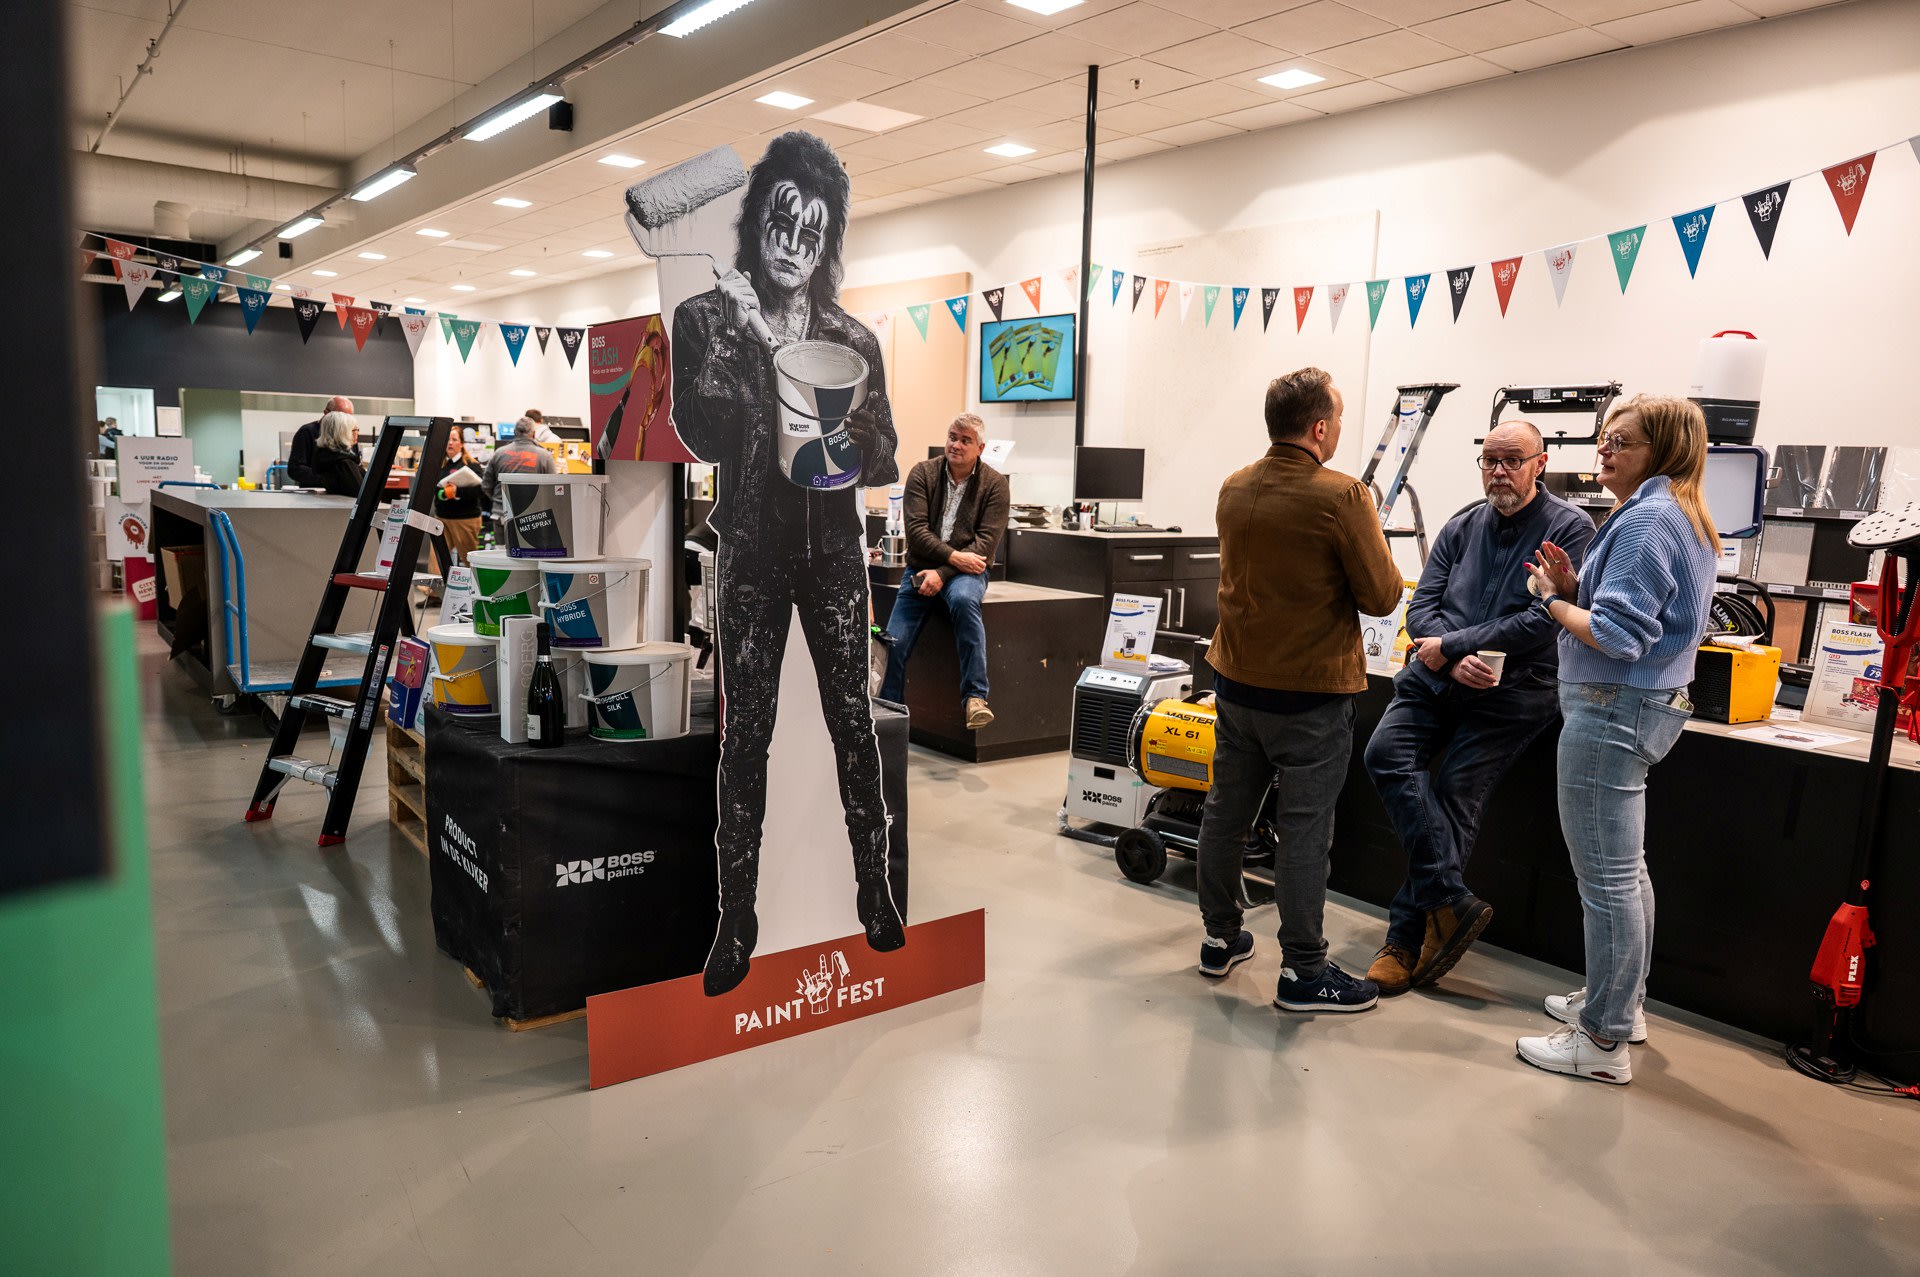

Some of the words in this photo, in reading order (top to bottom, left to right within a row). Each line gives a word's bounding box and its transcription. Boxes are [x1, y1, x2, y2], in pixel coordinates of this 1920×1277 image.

[591, 336, 606, 348] BOSS
[592, 347, 619, 366] FLASH
[520, 512, 547, 524] INTERIOR
[520, 524, 530, 532] MAT
[531, 519, 552, 530] SPRAY
[560, 602, 577, 613] BOSS
[557, 610, 586, 623] HYBRIDE
[1712, 604, 1736, 631] LUMX
[1830, 634, 1872, 645] MACHINES
[1869, 670, 1882, 678] 79
[607, 703, 622, 712] SILK
[1166, 711, 1214, 725] MASTER
[1164, 726, 1181, 736] XL
[1186, 730, 1200, 740] 61
[1102, 794, 1122, 803] BOSS
[445, 814, 478, 859] PRODUCT
[440, 835, 450, 856] IN
[450, 844, 462, 866] DE
[462, 854, 489, 894] KIJKER
[607, 850, 655, 868] BOSS
[607, 865, 644, 881] paints
[1848, 955, 1859, 982] FLEX
[735, 998, 805, 1034] PAINT
[837, 977, 885, 1008] FEST
